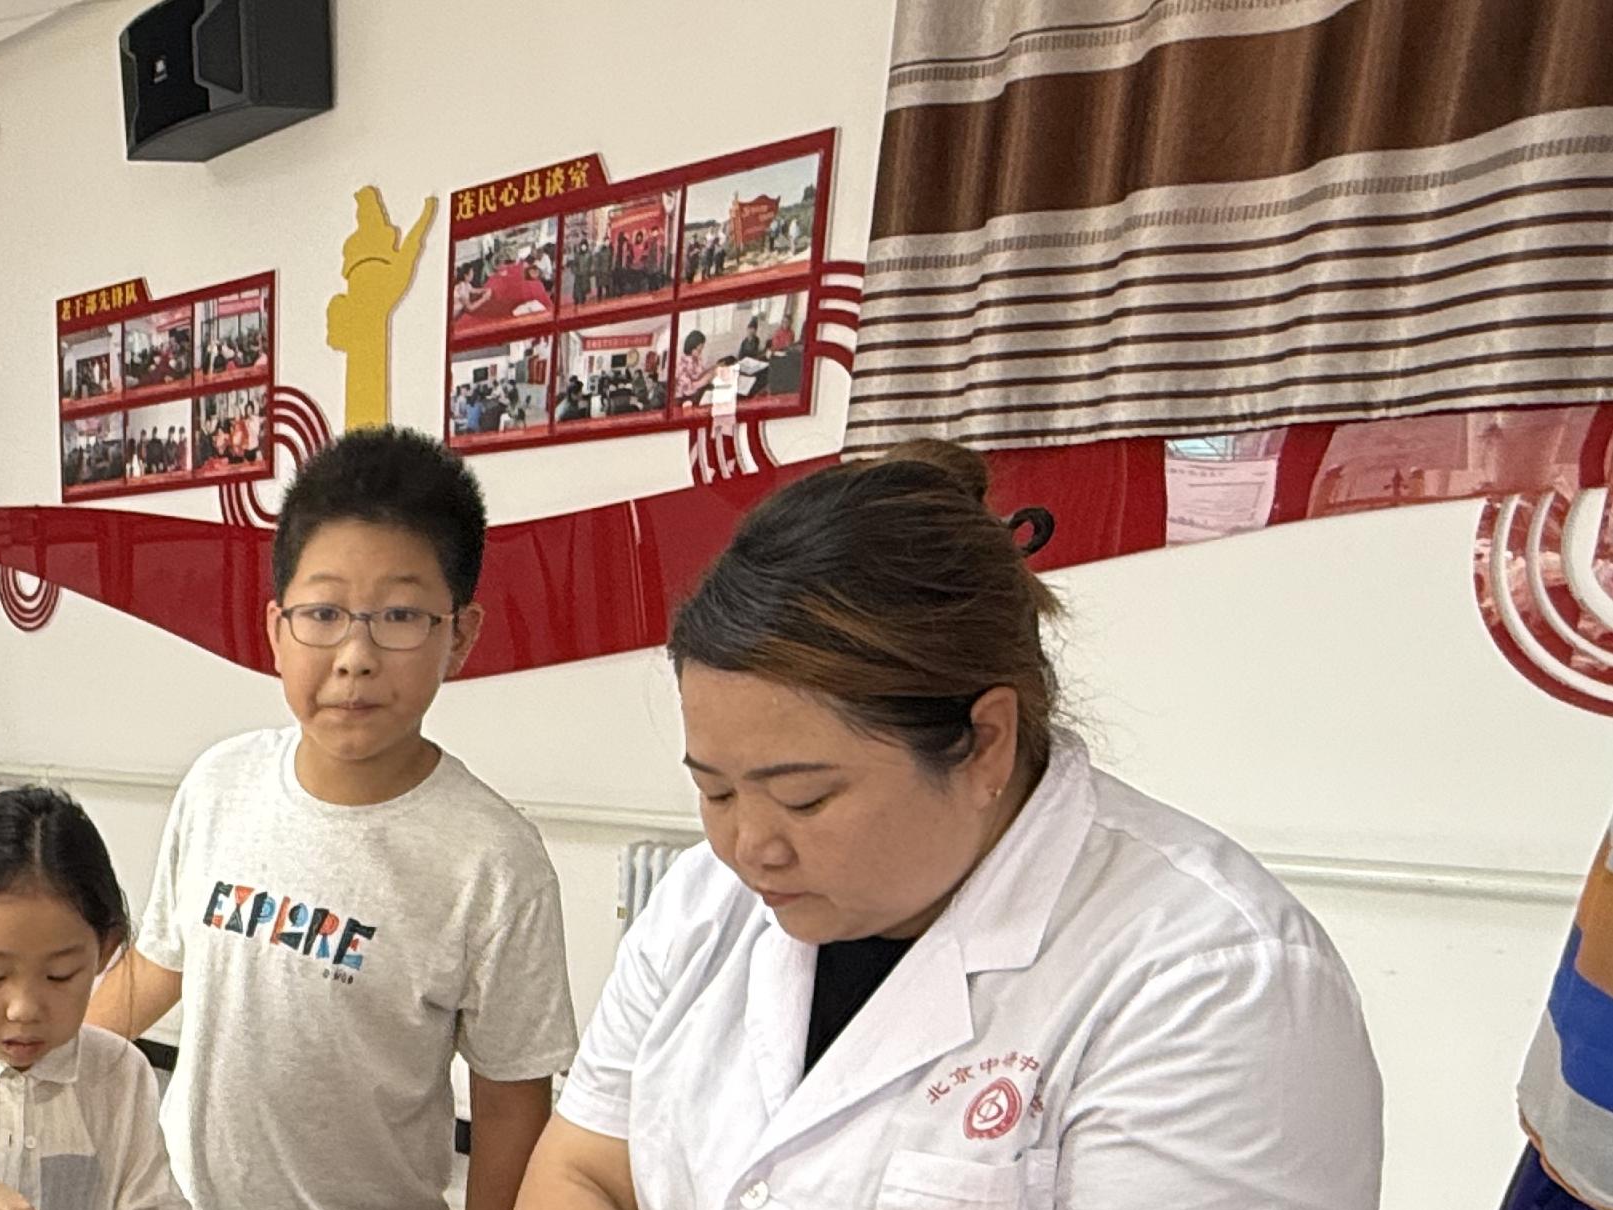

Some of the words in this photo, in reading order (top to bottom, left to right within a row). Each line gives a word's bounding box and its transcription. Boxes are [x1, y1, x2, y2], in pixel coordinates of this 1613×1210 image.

[455, 160, 590, 222] 连民心恳谈室
